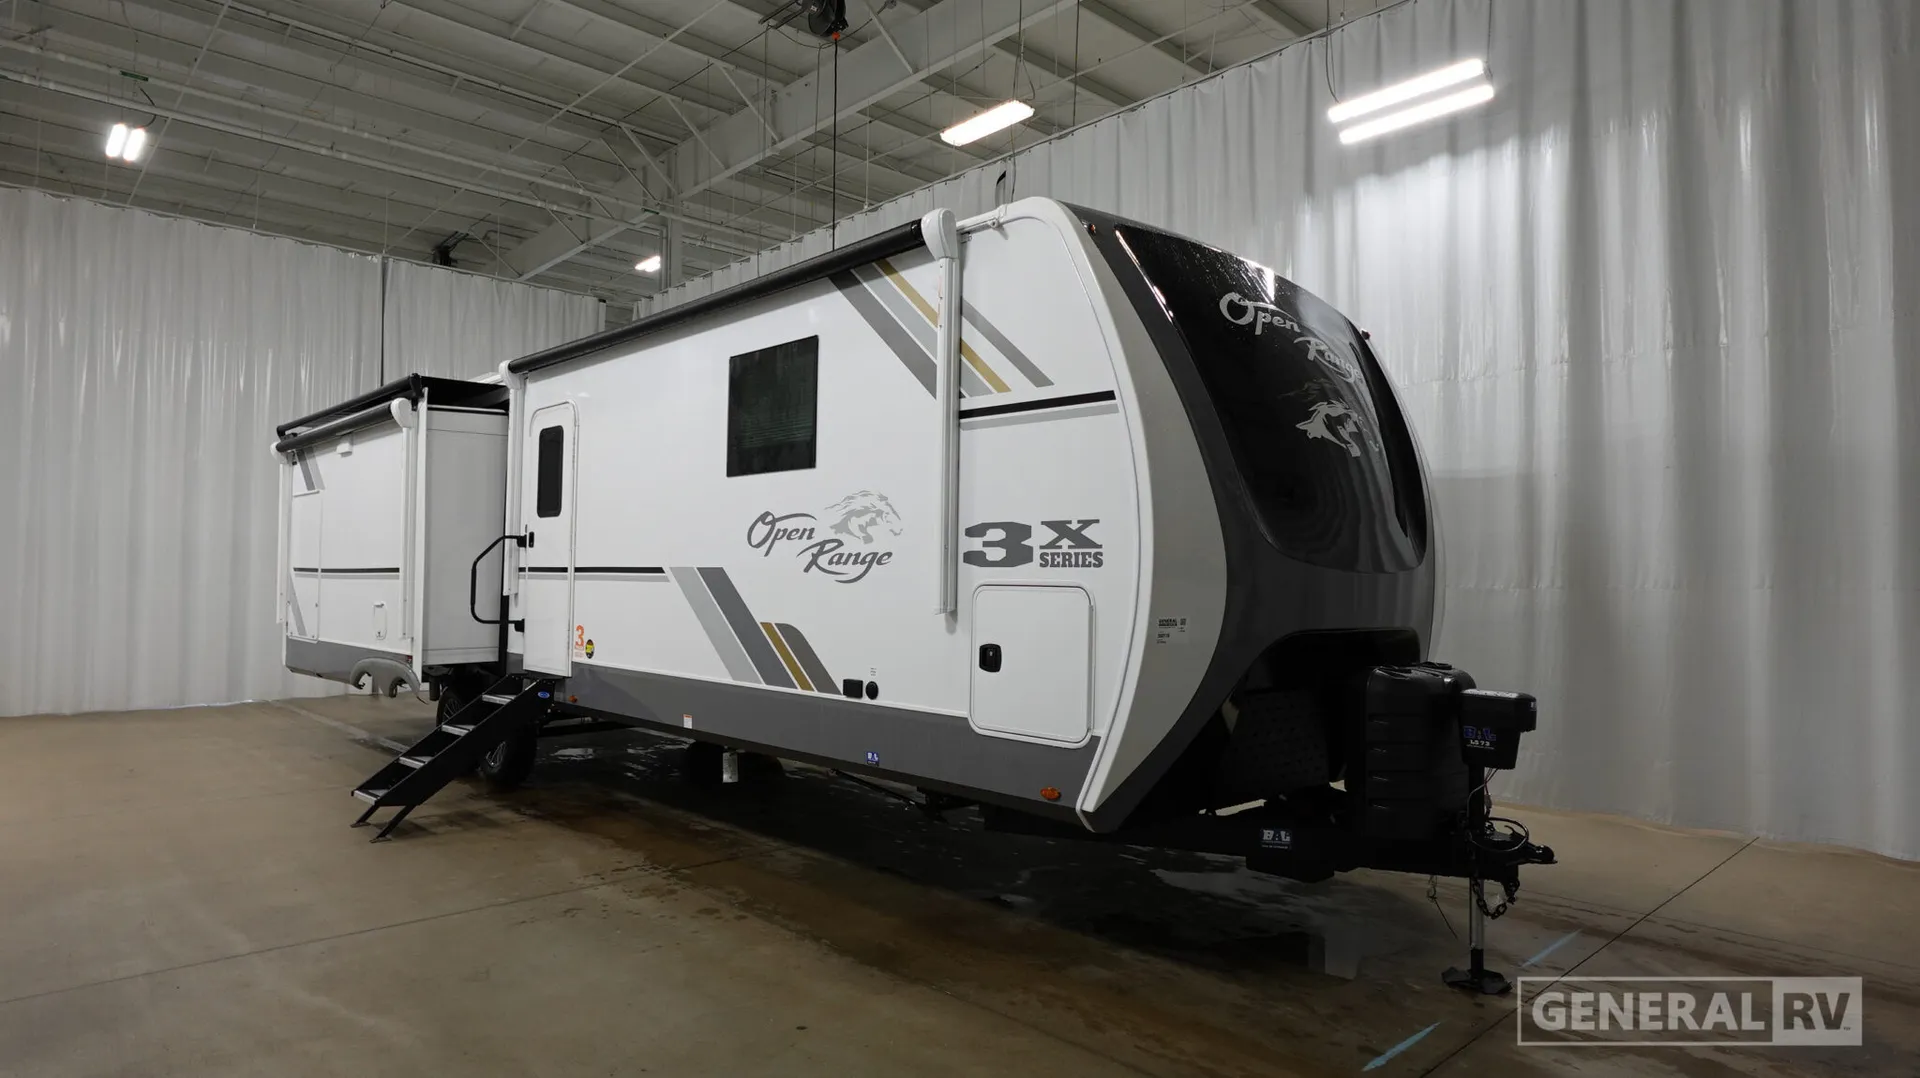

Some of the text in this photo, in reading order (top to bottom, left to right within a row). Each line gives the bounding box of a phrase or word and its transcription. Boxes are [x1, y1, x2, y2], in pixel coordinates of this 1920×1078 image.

[1219, 291, 1301, 336] Open
[1294, 337, 1364, 384] Range
[746, 510, 817, 557] Open
[963, 519, 1103, 568] 3 X
[797, 538, 894, 584] Range
[1039, 550, 1104, 568] SERIES
[575, 624, 585, 647] 3
